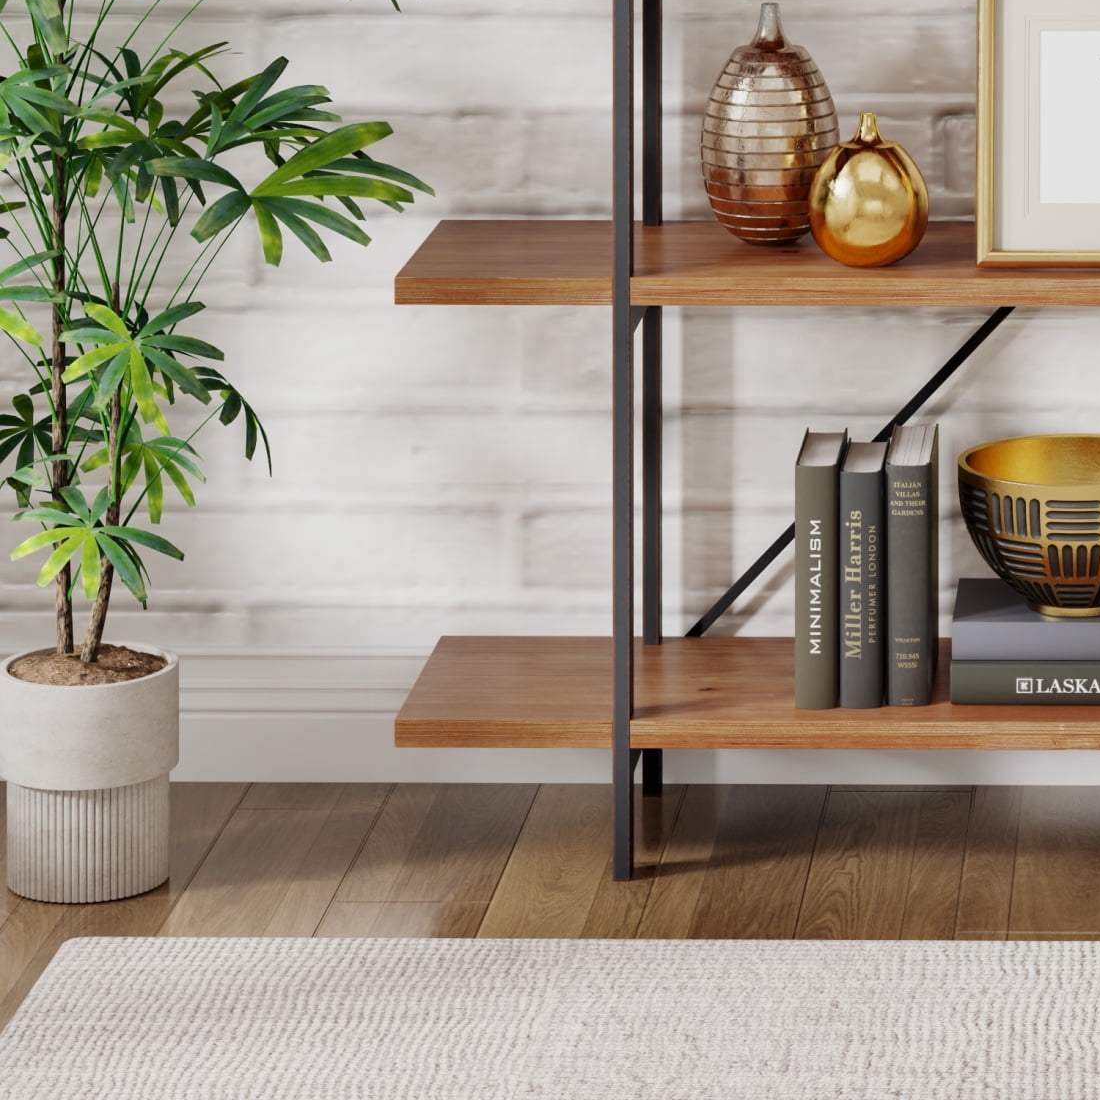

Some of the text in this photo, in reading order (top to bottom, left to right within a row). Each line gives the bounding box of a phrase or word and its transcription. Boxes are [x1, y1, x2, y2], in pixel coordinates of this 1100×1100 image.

[810, 519, 822, 654] MINIMALISM
[845, 510, 862, 659] Miller Harris
[868, 525, 877, 643] PERFUMER LONDON
